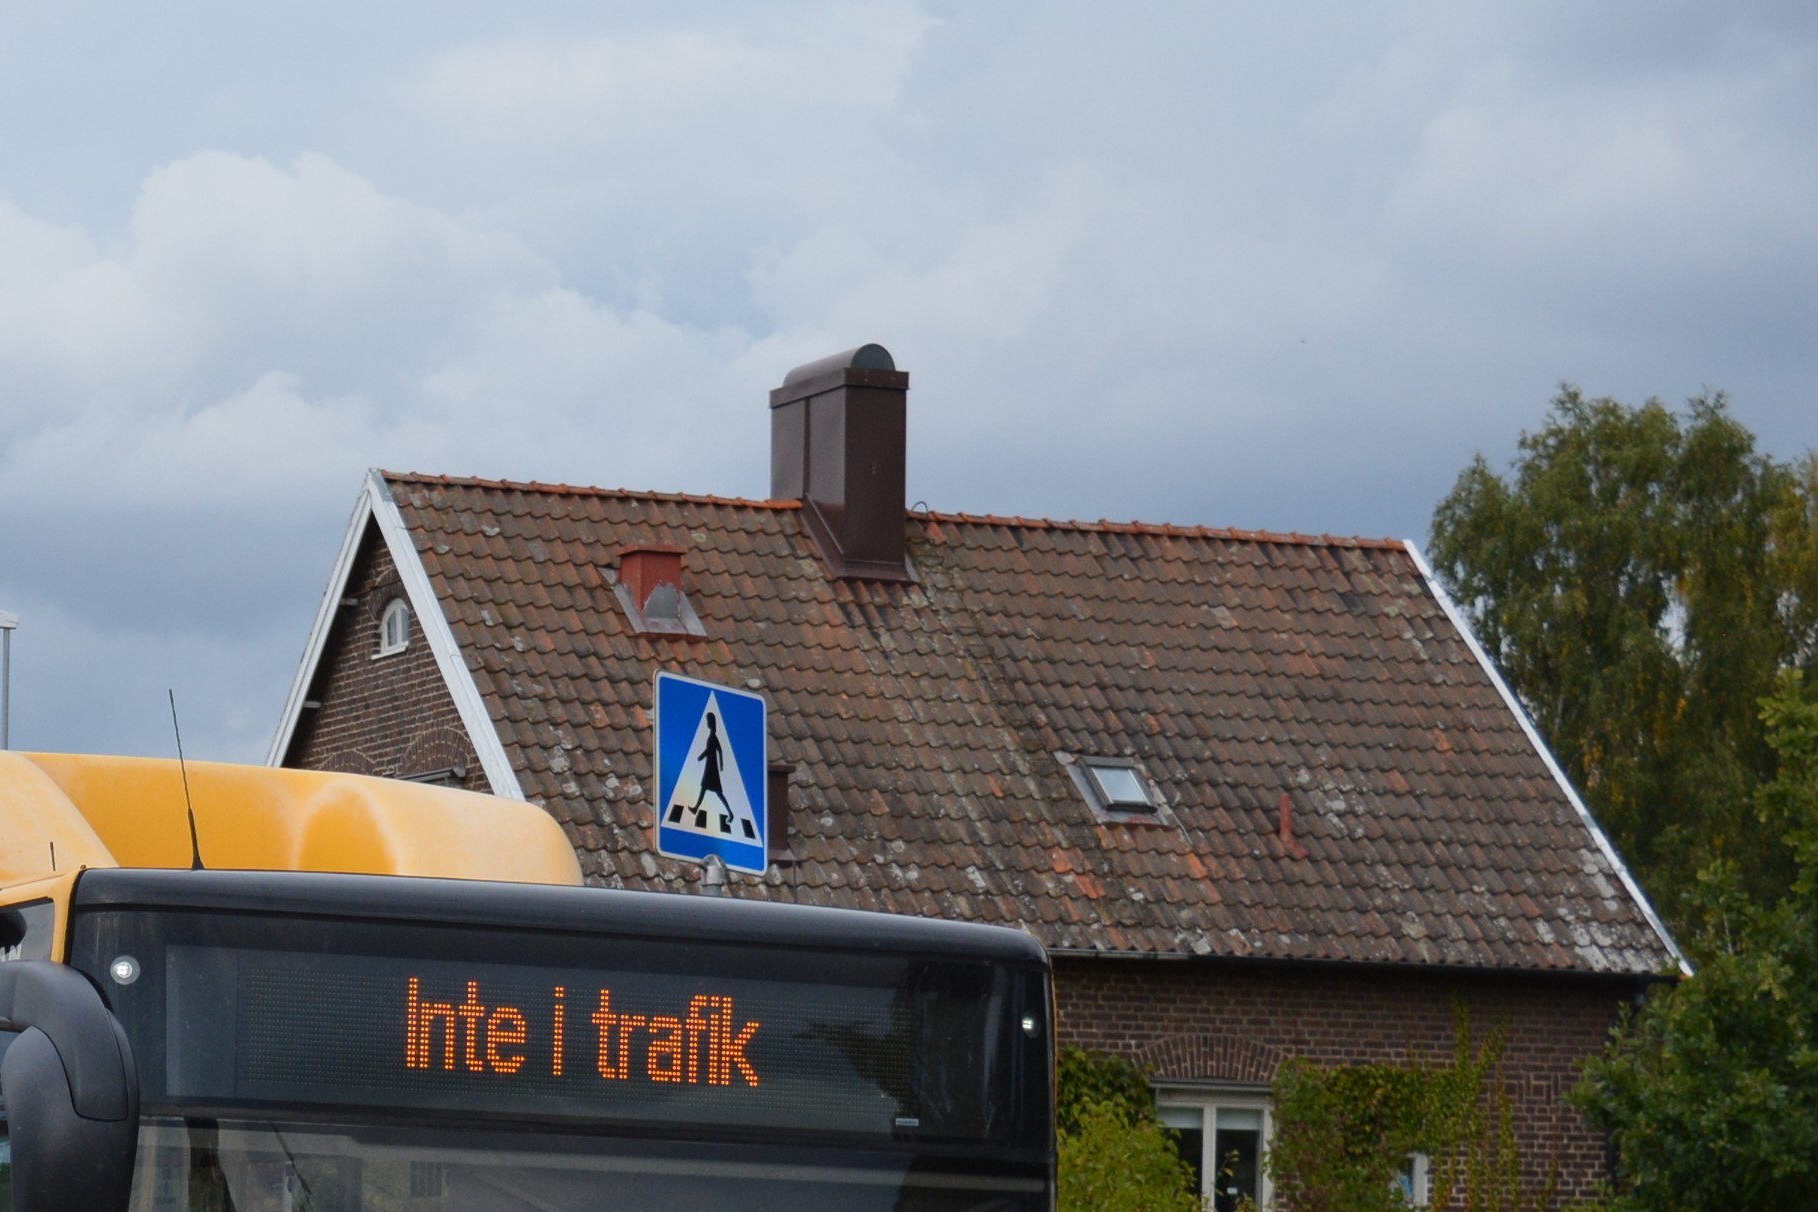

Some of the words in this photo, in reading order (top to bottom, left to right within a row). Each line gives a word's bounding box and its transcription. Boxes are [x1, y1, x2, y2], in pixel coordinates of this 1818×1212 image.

[406, 976, 527, 1073] Inte
[552, 985, 565, 1077] i
[590, 988, 760, 1087] trafik
